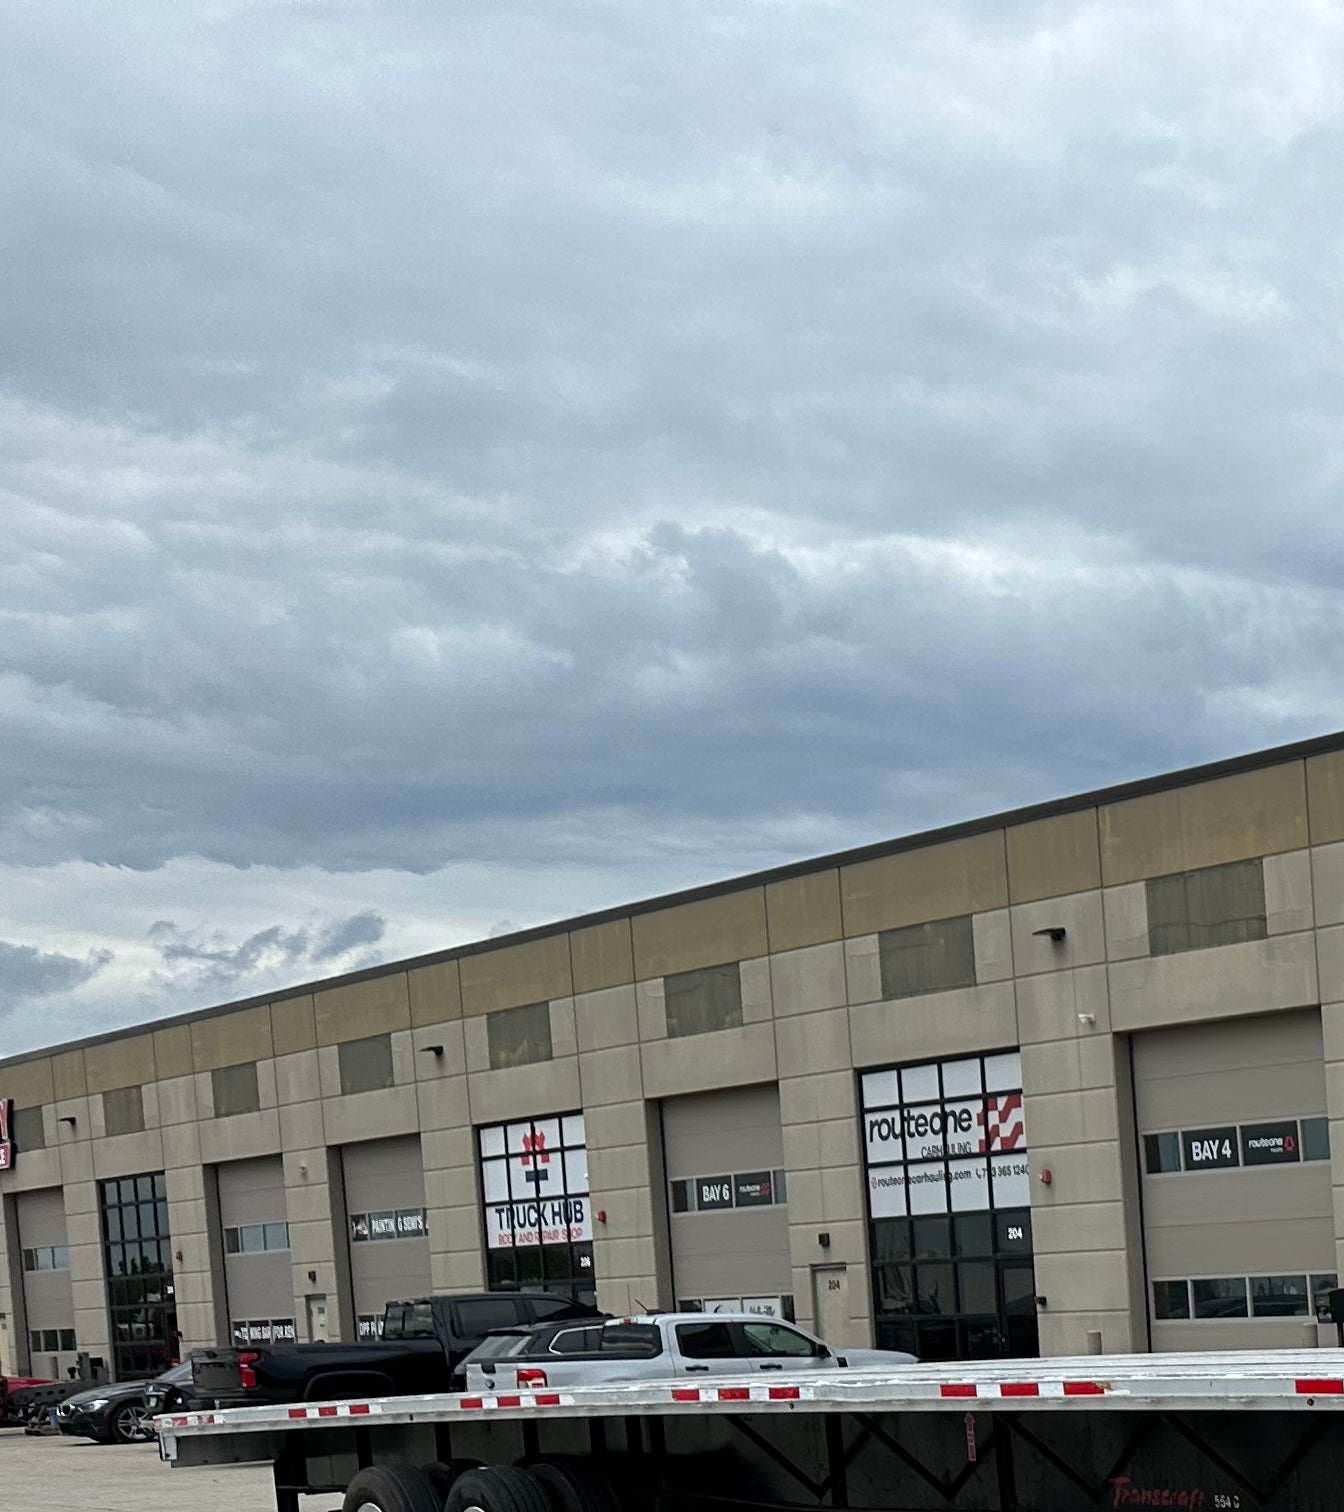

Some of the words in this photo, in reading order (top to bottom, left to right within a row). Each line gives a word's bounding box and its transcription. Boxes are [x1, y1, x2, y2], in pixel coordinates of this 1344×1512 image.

[869, 1108, 973, 1143] routeone
[1191, 1139, 1219, 1161] BAY
[1221, 1139, 1232, 1158] 4
[702, 1184, 721, 1202] BAY
[722, 1184, 730, 1201] 6
[495, 1203, 549, 1231] TRUCK
[551, 1199, 584, 1226] HUB
[1108, 1477, 1206, 1512] Transcraft
